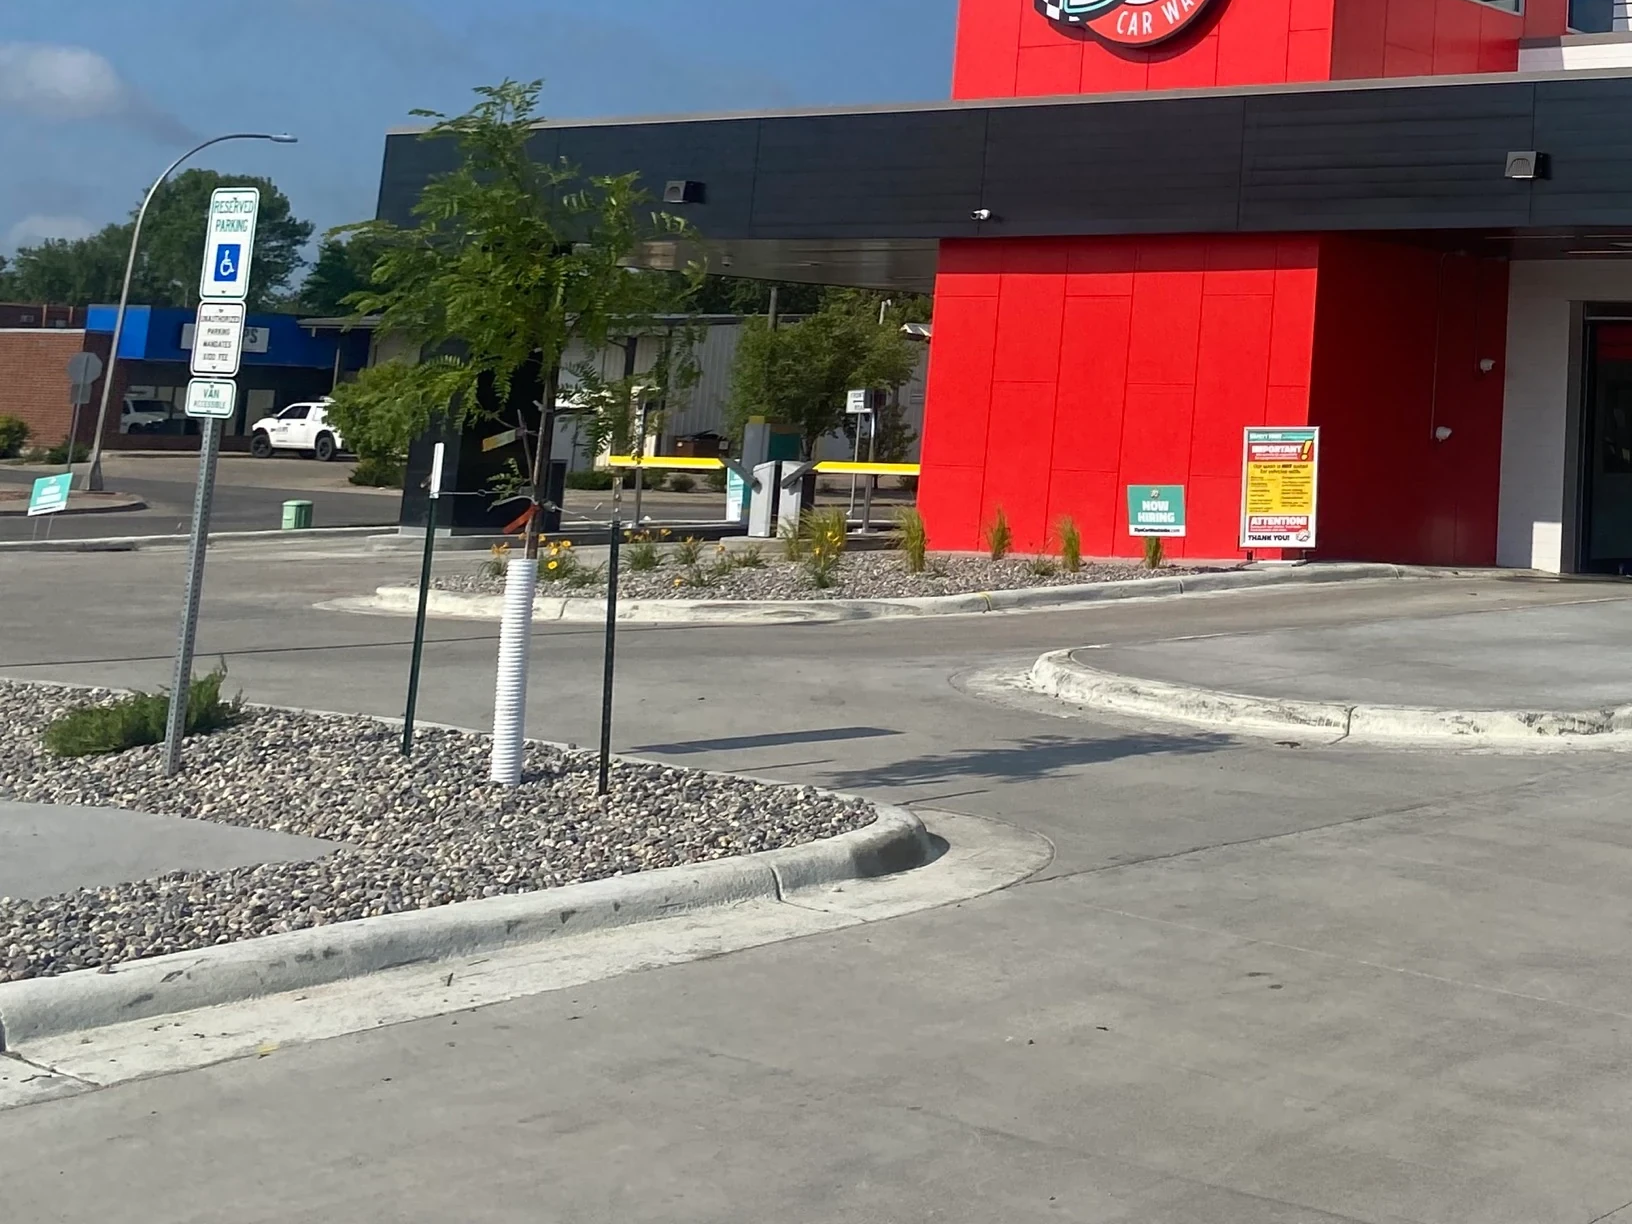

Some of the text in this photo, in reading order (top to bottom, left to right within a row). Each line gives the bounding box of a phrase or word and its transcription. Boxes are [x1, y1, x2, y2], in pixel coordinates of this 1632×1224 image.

[1116, 11, 1153, 36] CAR
[213, 200, 255, 214] RESERVED
[215, 219, 249, 233] PARKING
[207, 327, 231, 336] PARKING
[202, 340, 233, 349] MANDATES
[203, 388, 220, 399] VAN
[193, 400, 226, 410] ACCESSIBLE
[1142, 500, 1169, 512] NOW
[1137, 512, 1176, 523] HIRING
